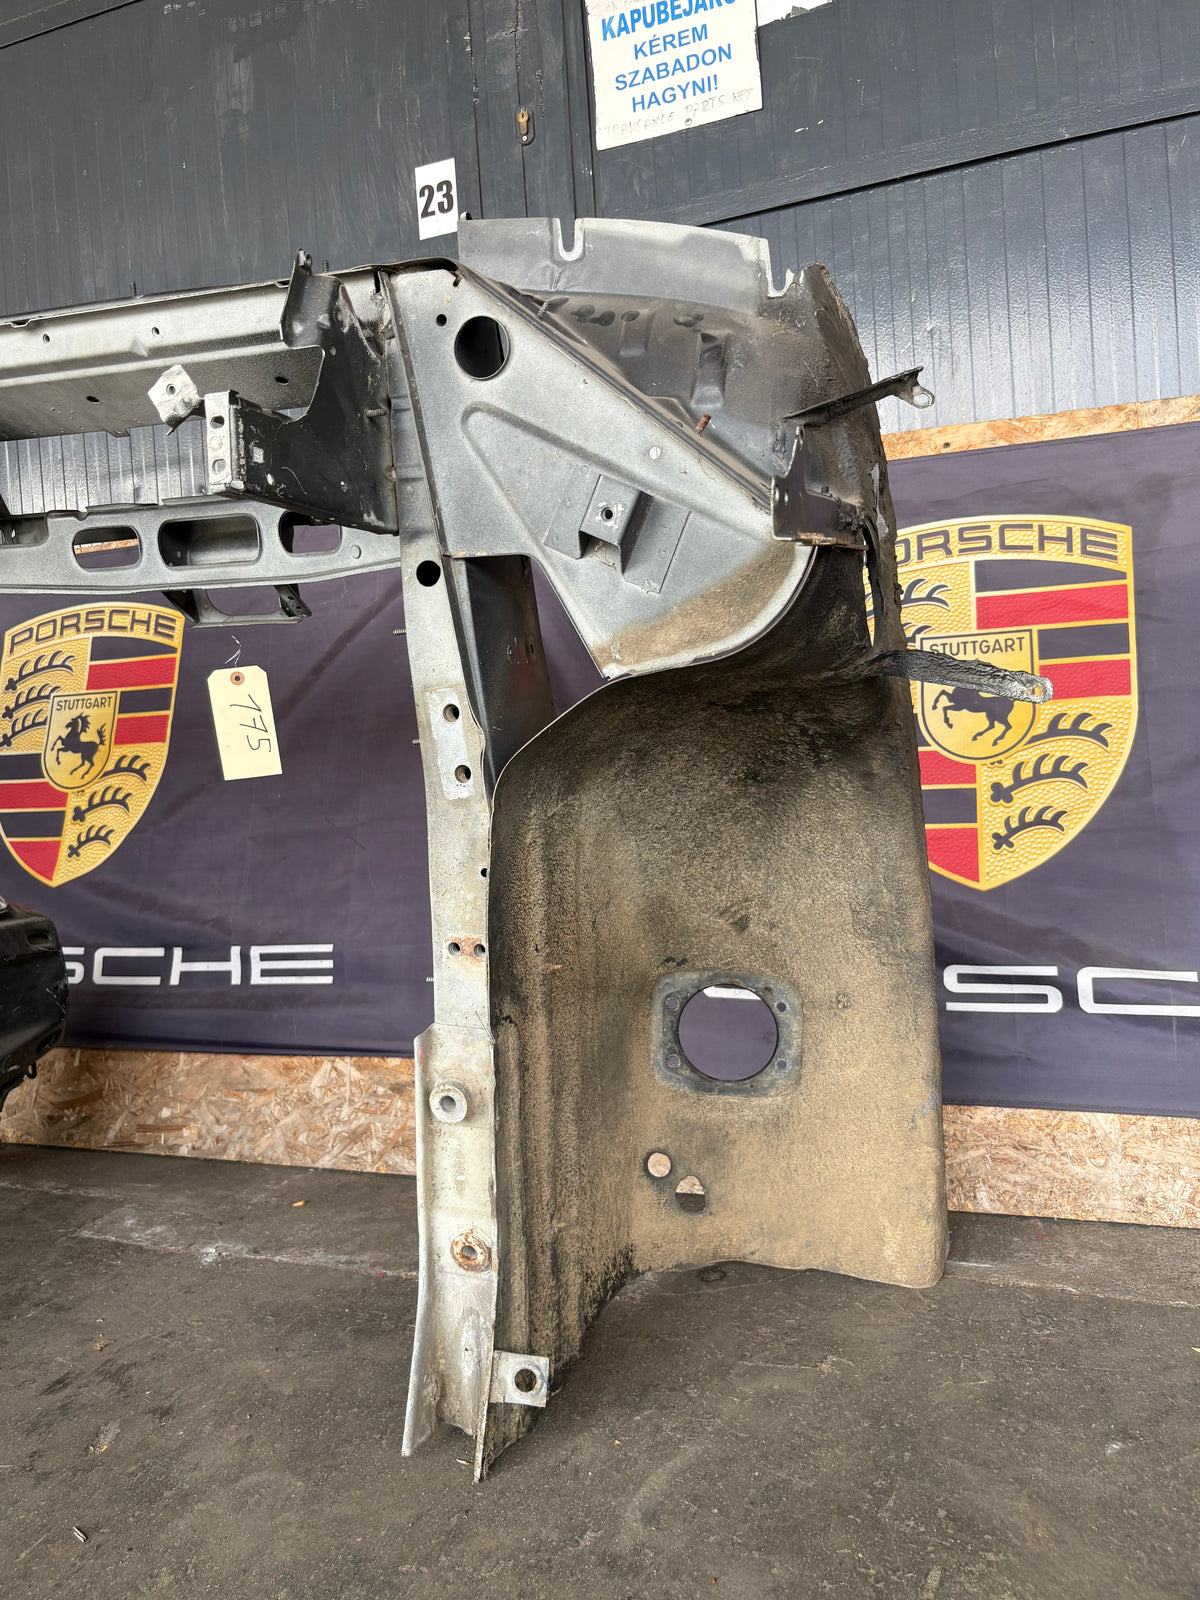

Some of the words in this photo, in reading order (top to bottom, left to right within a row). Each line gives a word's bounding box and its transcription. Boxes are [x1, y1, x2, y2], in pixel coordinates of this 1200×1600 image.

[634, 24, 708, 60] KÉREM
[615, 43, 732, 91] SZABADON
[631, 74, 718, 113] HAGYNI!
[419, 180, 454, 219] 23
[10, 609, 177, 654] PORSCHE
[929, 636, 1025, 657] STUTTGART
[56, 695, 113, 712] STUTTGART
[230, 694, 272, 753] 175
